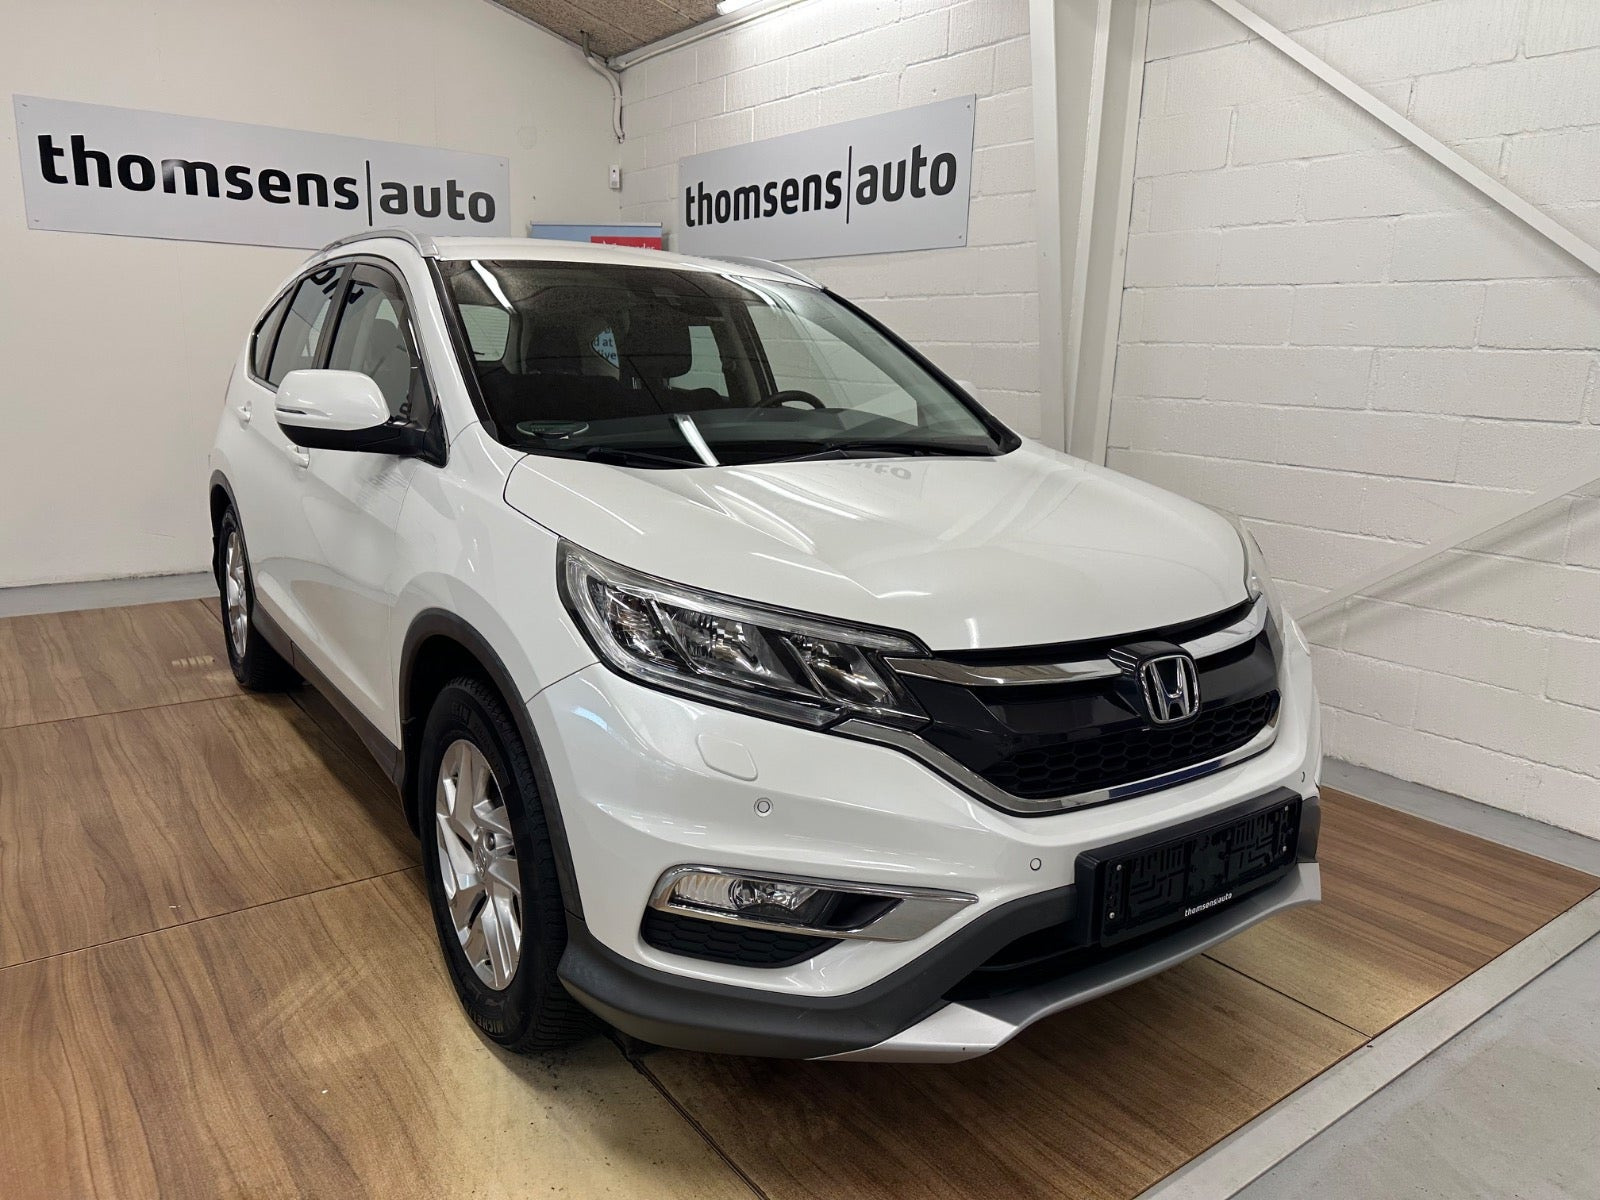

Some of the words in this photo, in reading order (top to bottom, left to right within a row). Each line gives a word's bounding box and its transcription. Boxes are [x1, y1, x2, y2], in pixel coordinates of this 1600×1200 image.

[37, 134, 361, 211] thomsens
[379, 178, 497, 224] auto
[685, 170, 843, 228] thomsens
[856, 144, 957, 206] auto
